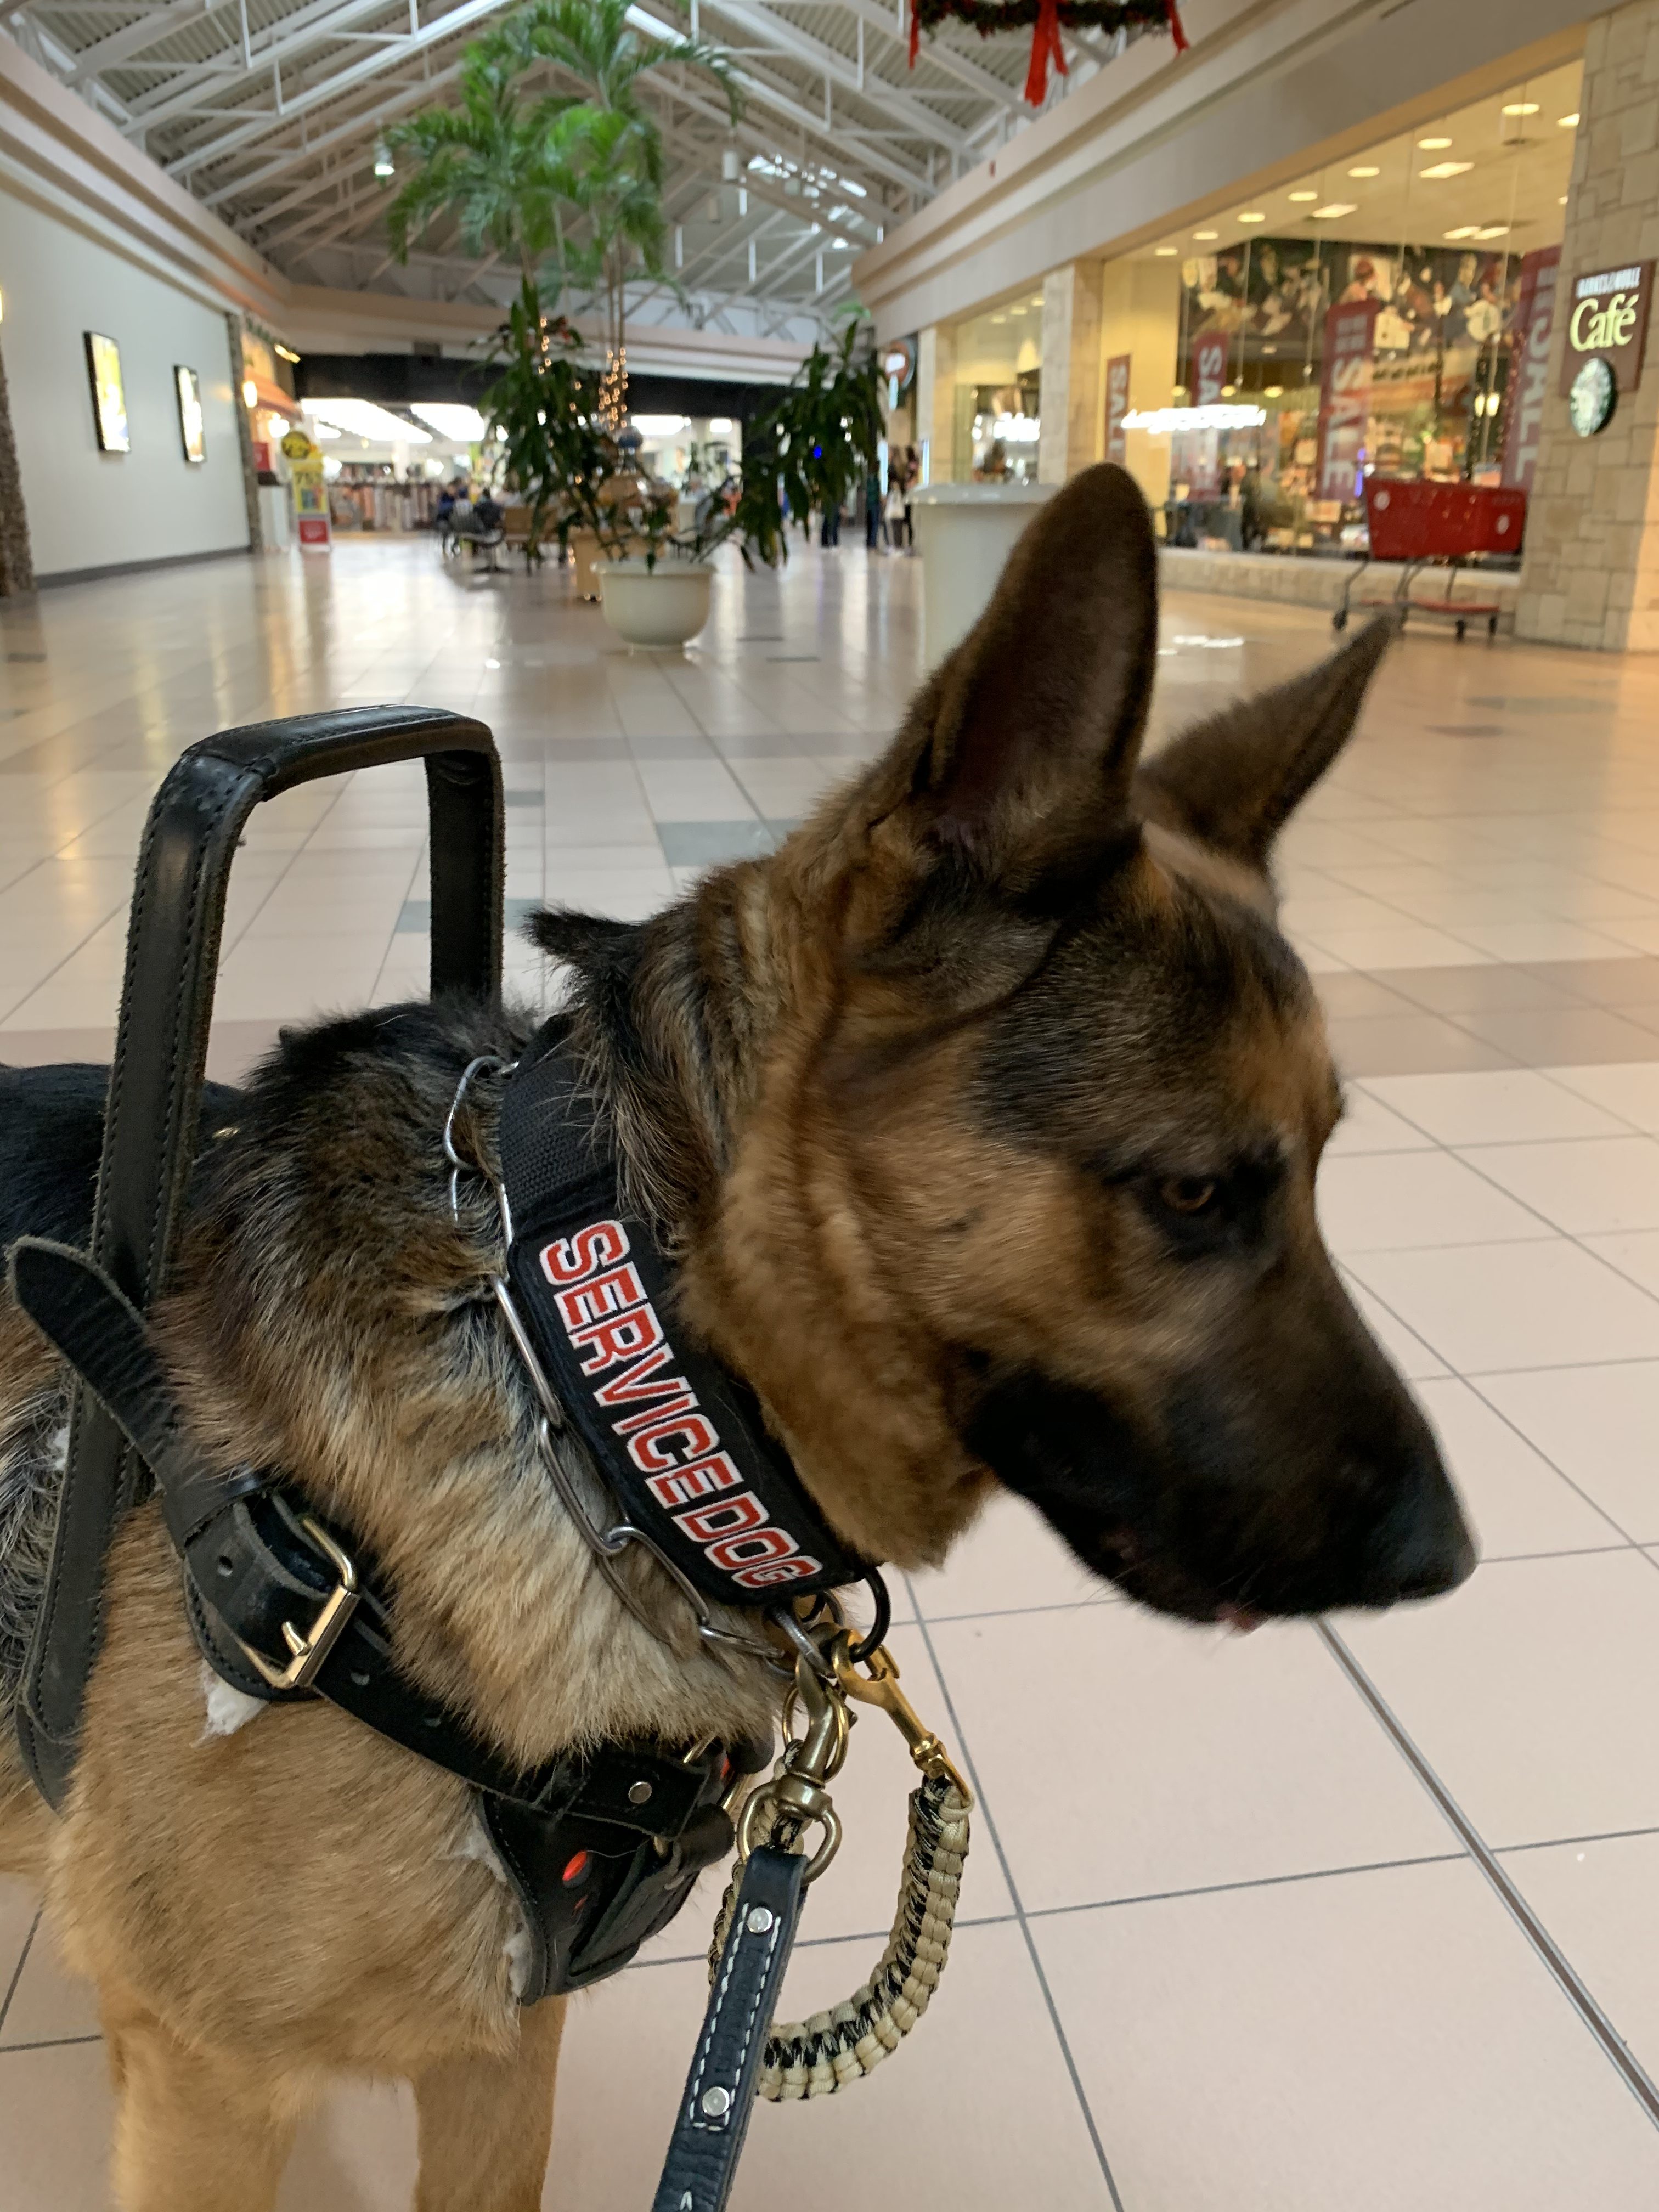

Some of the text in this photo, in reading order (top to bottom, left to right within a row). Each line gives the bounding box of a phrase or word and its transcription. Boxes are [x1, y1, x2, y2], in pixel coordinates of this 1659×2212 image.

[1570, 293, 1639, 352] Café
[1323, 357, 1367, 489] SALE
[539, 1219, 823, 1589] SERVICE DOG
